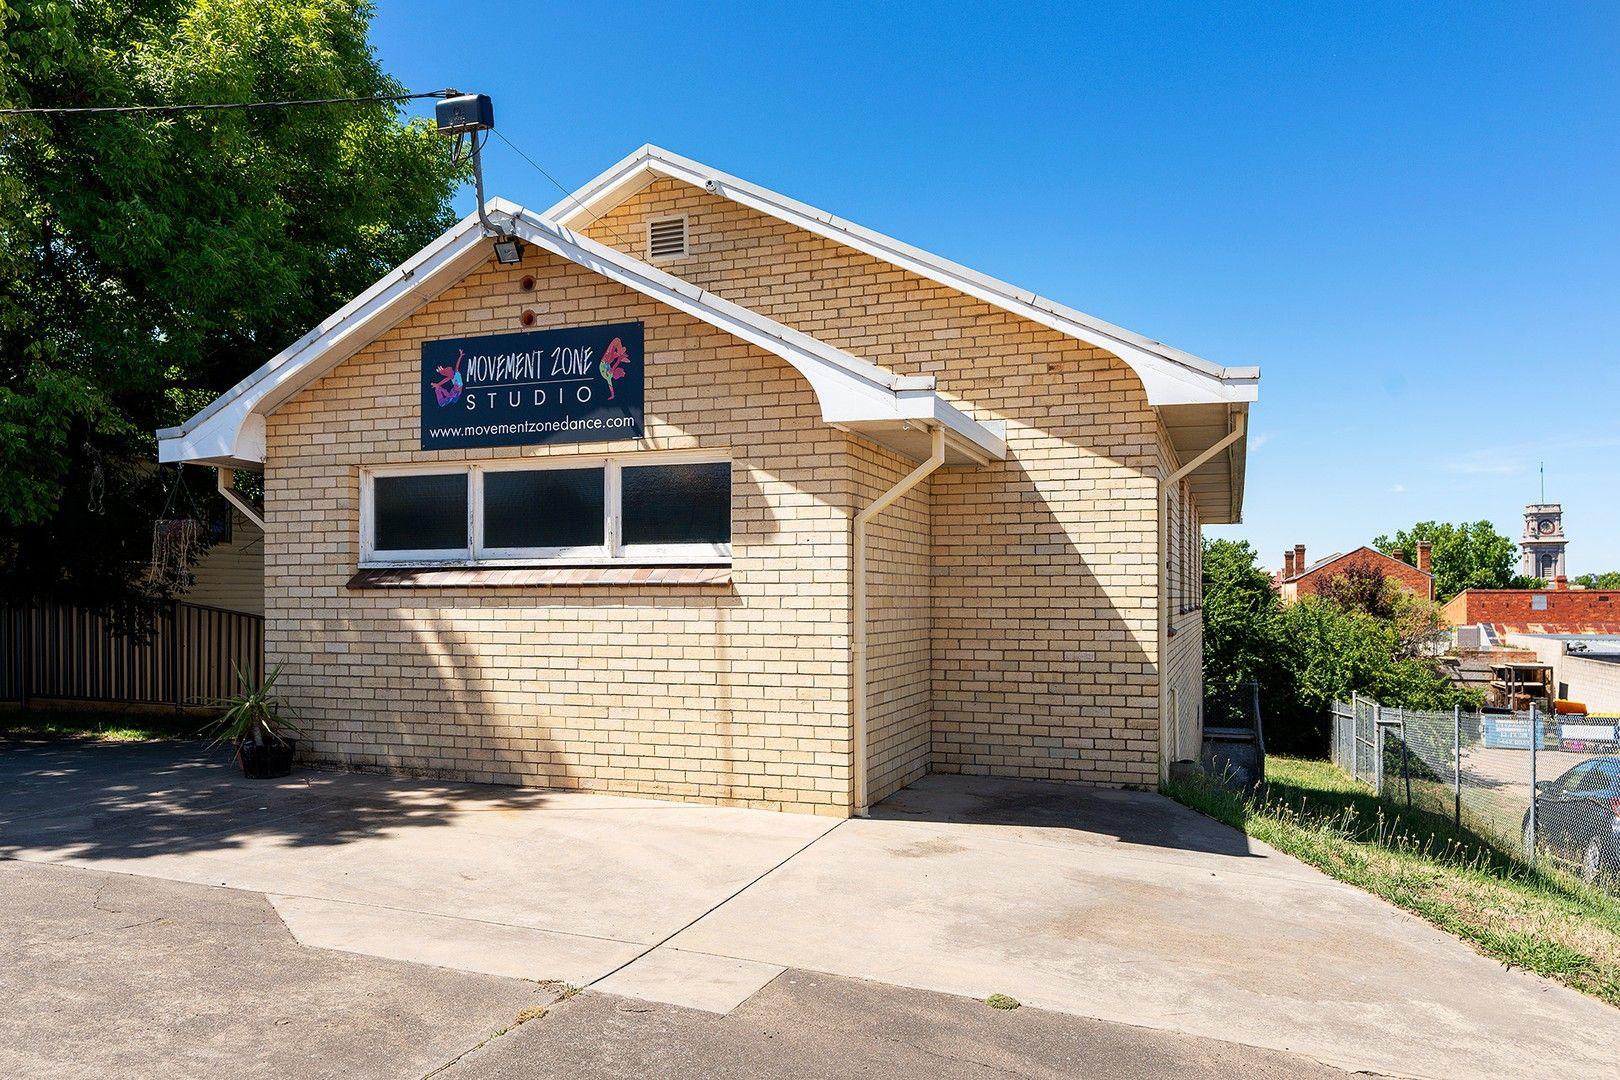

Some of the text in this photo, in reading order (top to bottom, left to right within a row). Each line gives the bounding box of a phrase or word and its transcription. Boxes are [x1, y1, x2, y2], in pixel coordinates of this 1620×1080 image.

[466, 345, 593, 383] MOVEMENT ZONE
[466, 386, 592, 410] STUDIO
[430, 415, 635, 438] www.movementzonedance.com
